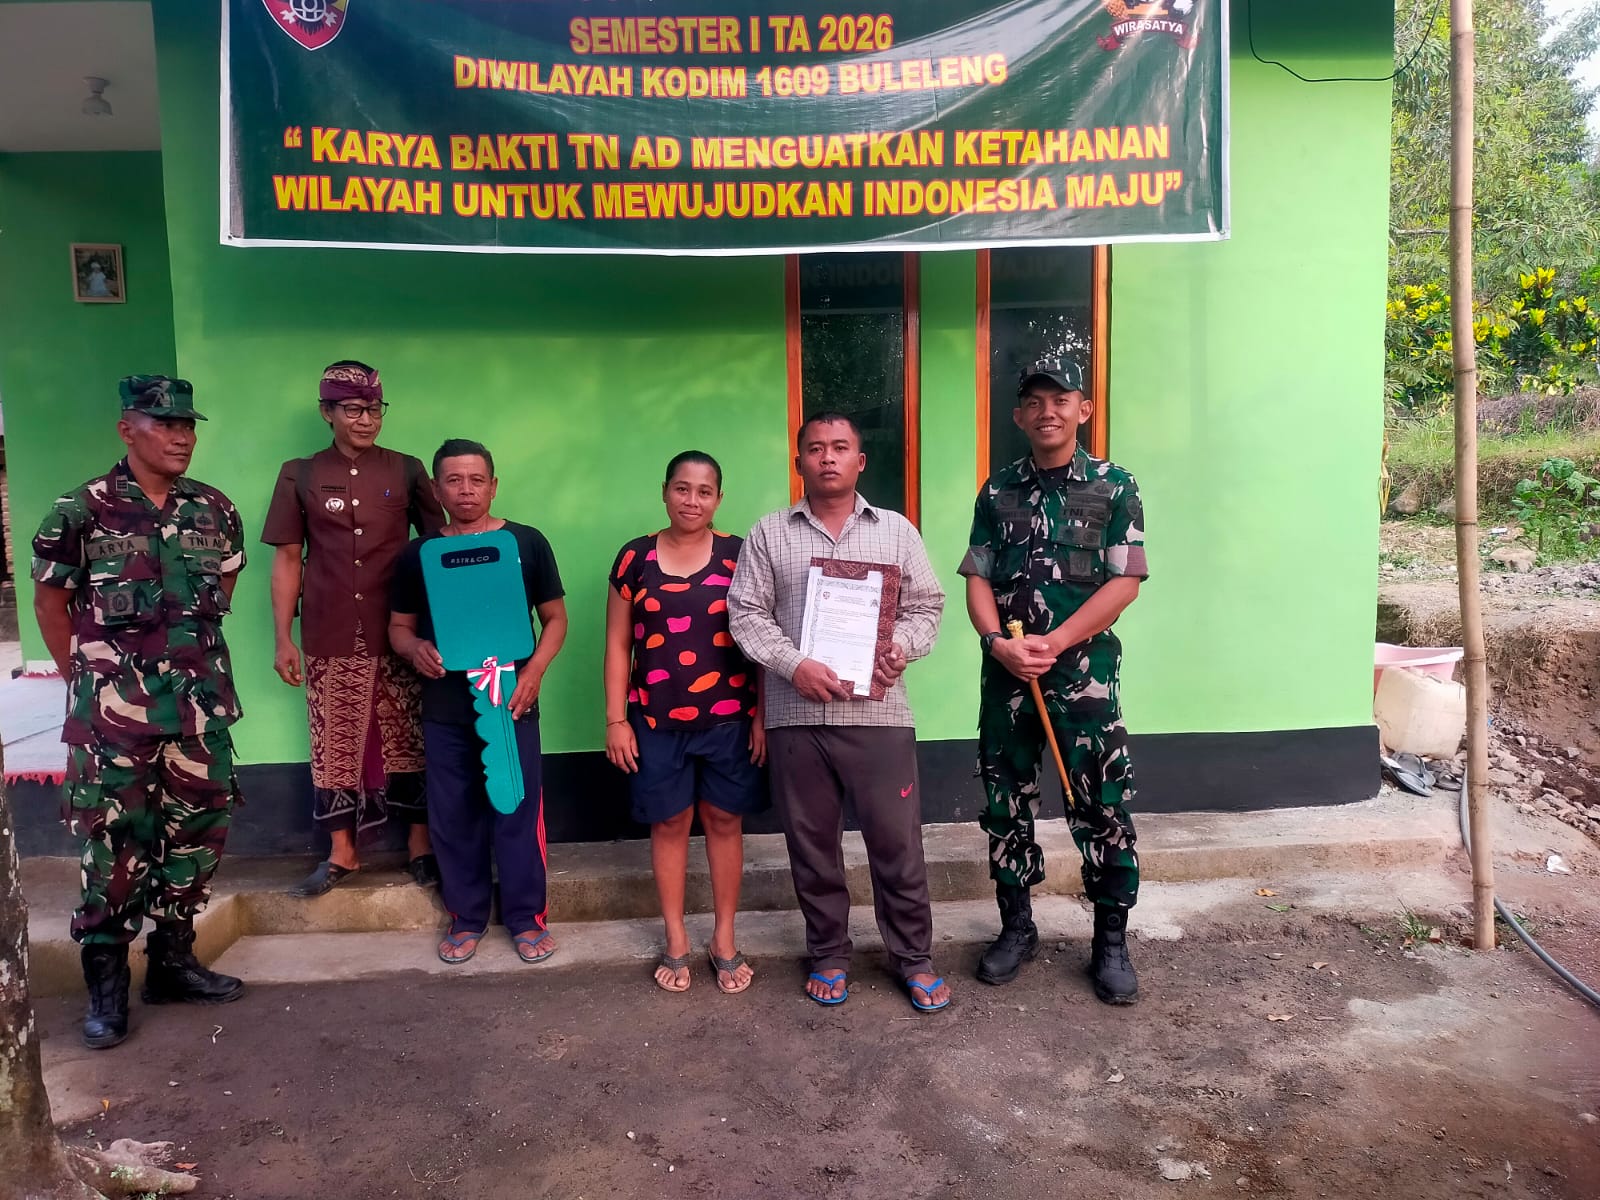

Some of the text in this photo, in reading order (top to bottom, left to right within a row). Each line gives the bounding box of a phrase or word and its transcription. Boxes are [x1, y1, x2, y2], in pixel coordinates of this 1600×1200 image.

[570, 14, 893, 54] SEMESTER I TA 2026
[1113, 20, 1184, 36] WIRASATYA
[454, 53, 1008, 98] DIWILAYAH KODIM 1609 BULELENG
[312, 127, 442, 170] KARYA
[450, 134, 559, 170] BAKTI
[567, 133, 620, 169] TN
[630, 136, 682, 169] AD
[691, 130, 944, 169] MENGUATKAN
[954, 124, 1170, 167] KETAHANAN
[273, 175, 441, 215] WILAYAH
[453, 183, 585, 219] UNTUK
[592, 181, 853, 218] MEWUJUDKAN
[864, 176, 1059, 216] INDONESIA
[99, 540, 135, 555] ARYA
[187, 536, 208, 547] TNI
